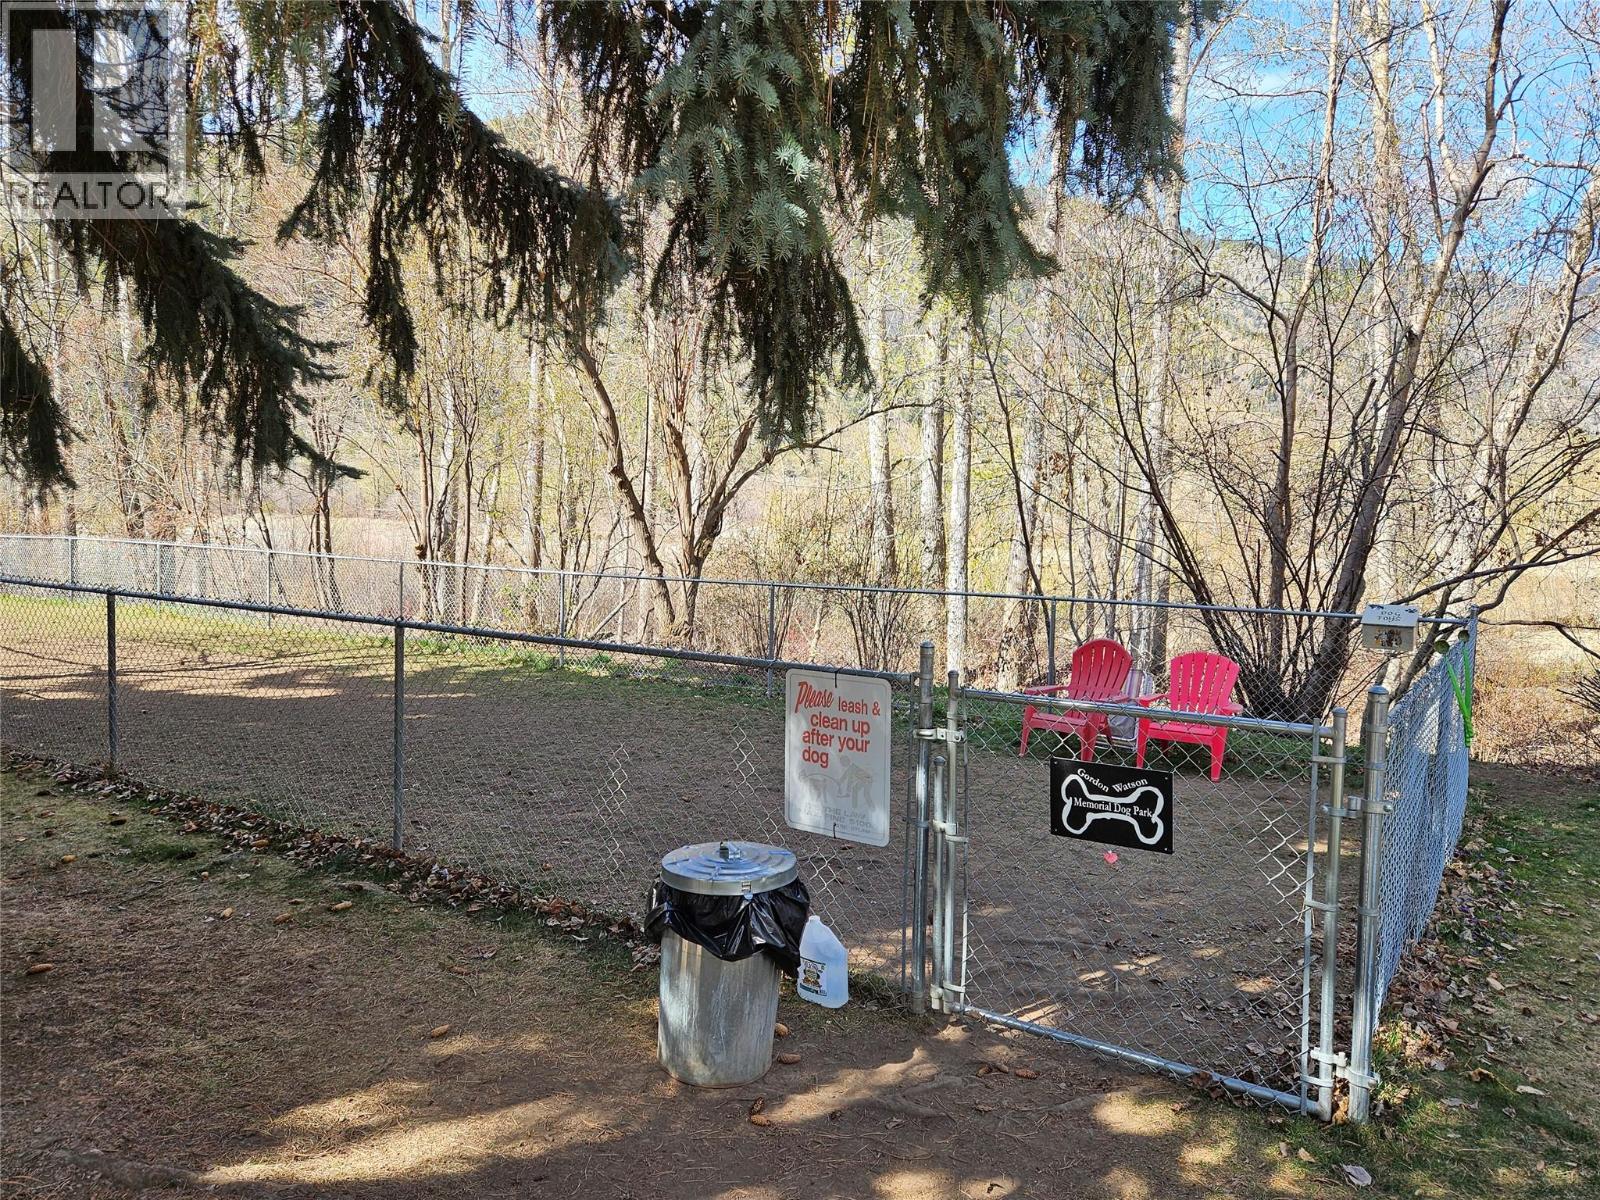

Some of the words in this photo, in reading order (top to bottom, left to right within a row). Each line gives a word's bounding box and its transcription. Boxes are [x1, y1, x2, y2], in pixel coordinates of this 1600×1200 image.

[795, 681, 835, 713] Please
[838, 696, 868, 715] leash
[872, 701, 881, 716] &
[810, 711, 848, 731] clean
[852, 720, 870, 735] up
[802, 729, 835, 747] after
[838, 736, 870, 752] your
[802, 747, 829, 768] dog
[1077, 768, 1109, 793] Gordon
[1112, 778, 1148, 793] Watson
[1073, 798, 1112, 812] Memorial
[1114, 802, 1132, 816] Dog
[1133, 805, 1153, 818] Park
